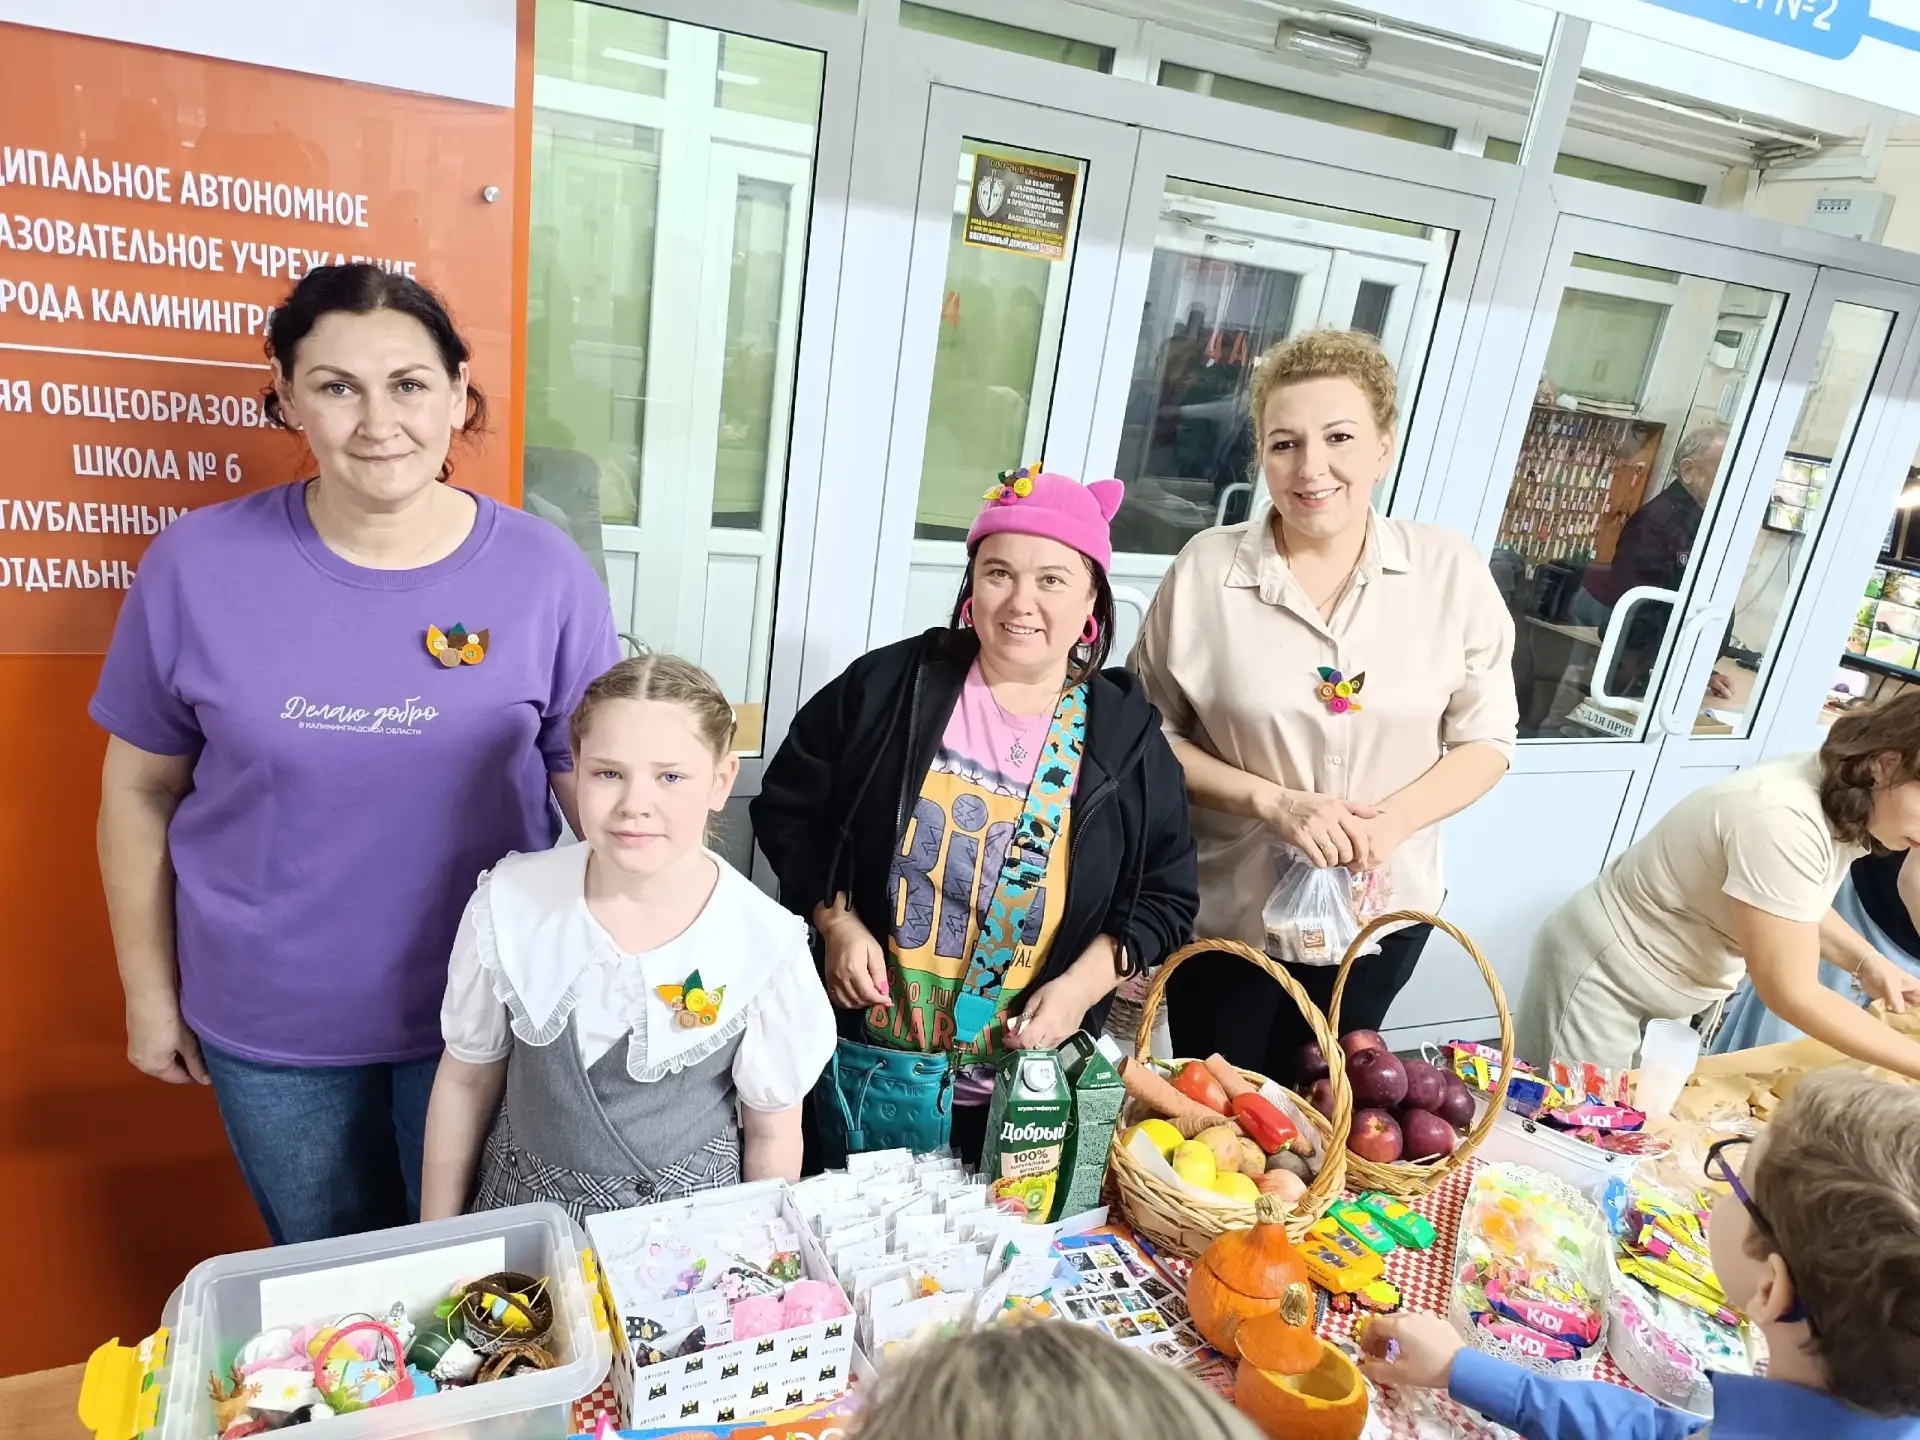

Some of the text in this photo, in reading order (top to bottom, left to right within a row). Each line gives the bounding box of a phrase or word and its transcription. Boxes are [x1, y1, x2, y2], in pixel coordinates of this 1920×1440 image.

[0, 146, 369, 228] ИПАЛЬНОЕ АВТОНОМНОЕ
[0, 212, 417, 282] АЗОВАТЕЛЬНОЕ УЧРЕЖИЕ
[73, 444, 241, 483] ШКОЛА № 6
[281, 695, 439, 730] Делаю добро
[1584, 711, 1606, 727] ДЛЯ
[305, 722, 384, 733] КАЛИНИНГРАДСКОЙ
[386, 727, 422, 735] ОБЛАСТИ
[1000, 1121, 1067, 1143] Добрый
[1013, 1149, 1048, 1163] 100%
